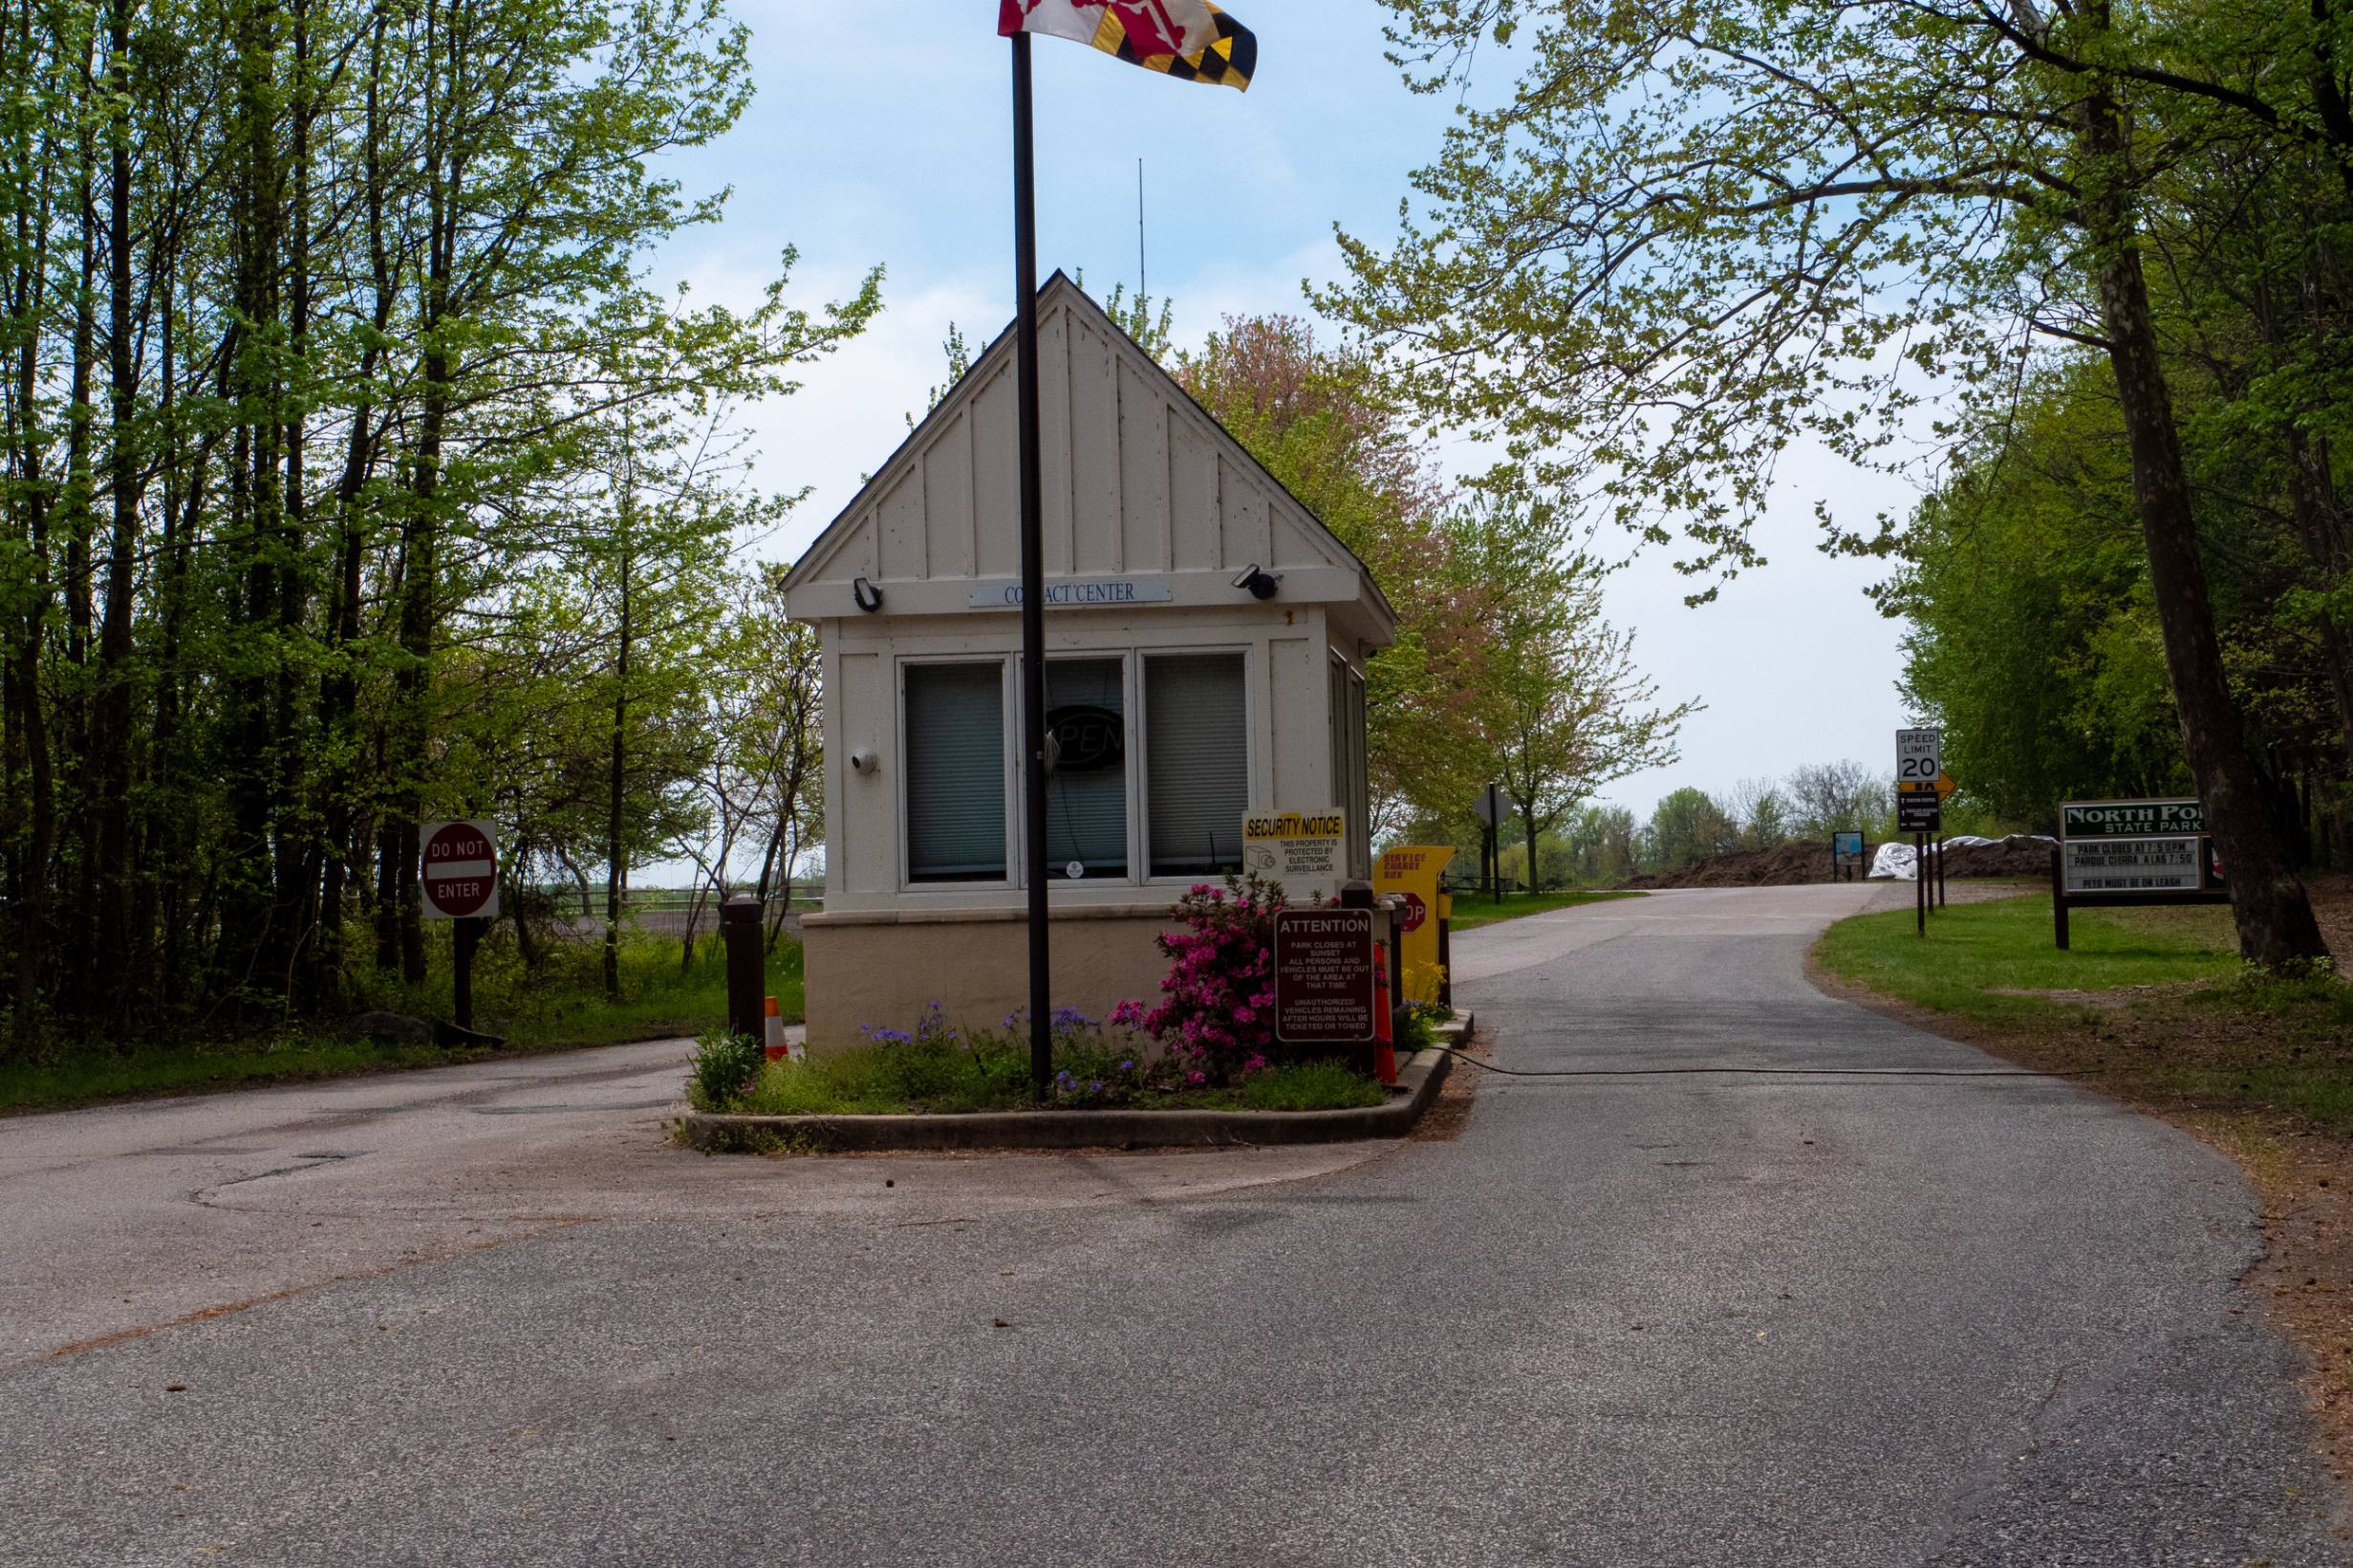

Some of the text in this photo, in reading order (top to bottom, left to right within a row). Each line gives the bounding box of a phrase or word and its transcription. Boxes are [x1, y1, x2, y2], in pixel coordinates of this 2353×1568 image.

[1004, 583, 1134, 604] COACT CENTER
[1059, 723, 1123, 753] PEN
[1900, 734, 1935, 743] SPEED
[1904, 745, 1932, 754] LIMIT
[1902, 758, 1935, 777] 20
[2067, 808, 2155, 824] NORTH
[1247, 816, 1341, 837] SECURITY NOTICE
[2105, 820, 2202, 833] STATE PARK
[432, 841, 485, 857] DO NOT
[1284, 847, 1334, 856] PROTECTED BY
[2078, 845, 2100, 855] PARK
[2102, 844, 2132, 853] CLOSES
[2134, 843, 2145, 852] AT
[2074, 856, 2105, 866] PARQUE
[2108, 855, 2139, 865] CIERRA
[1284, 864, 1334, 872] SURVEILLANCE
[2083, 879, 2103, 889] PETS
[2105, 878, 2127, 888] MUST
[2130, 878, 2139, 888] BE
[2156, 877, 2181, 888] LEASH
[438, 883, 480, 898] ENTER
[1406, 905, 1424, 921] OP
[1280, 919, 1369, 933] ATTENTION
